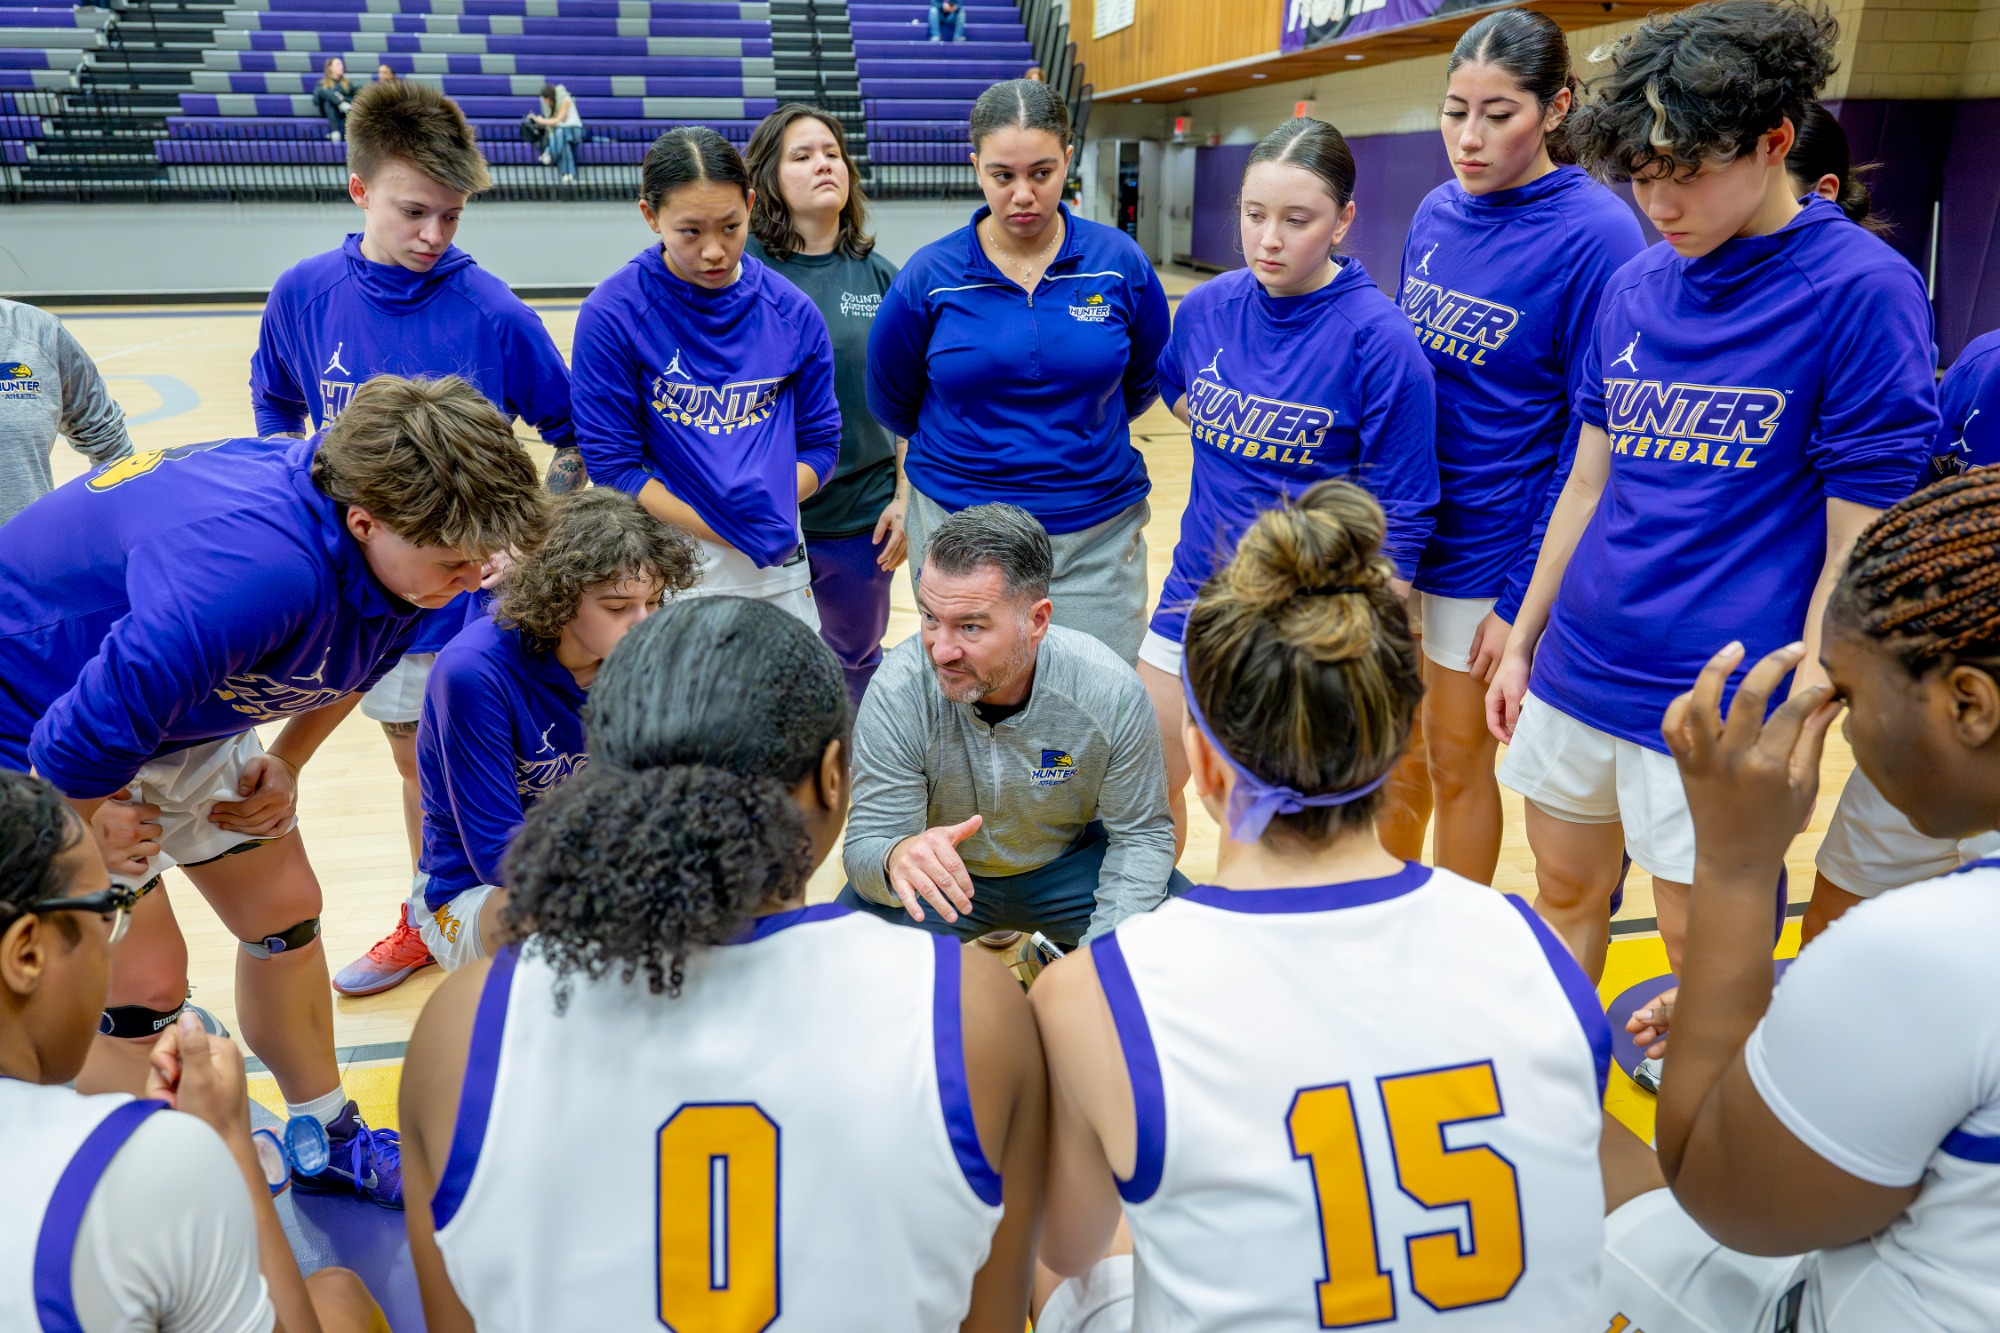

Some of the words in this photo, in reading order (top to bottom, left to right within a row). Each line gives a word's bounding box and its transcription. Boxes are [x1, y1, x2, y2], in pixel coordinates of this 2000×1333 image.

[1069, 304, 1111, 317] HUNTER
[1414, 327, 1487, 366] ETBALL
[0, 379, 41, 392] UNTER
[1188, 377, 1334, 447] HUNTER
[1190, 419, 1314, 465] SKETBALL
[1030, 768, 1079, 781] HUNTER
[1284, 1058, 1527, 1330] 15
[656, 1101, 782, 1333] 0
